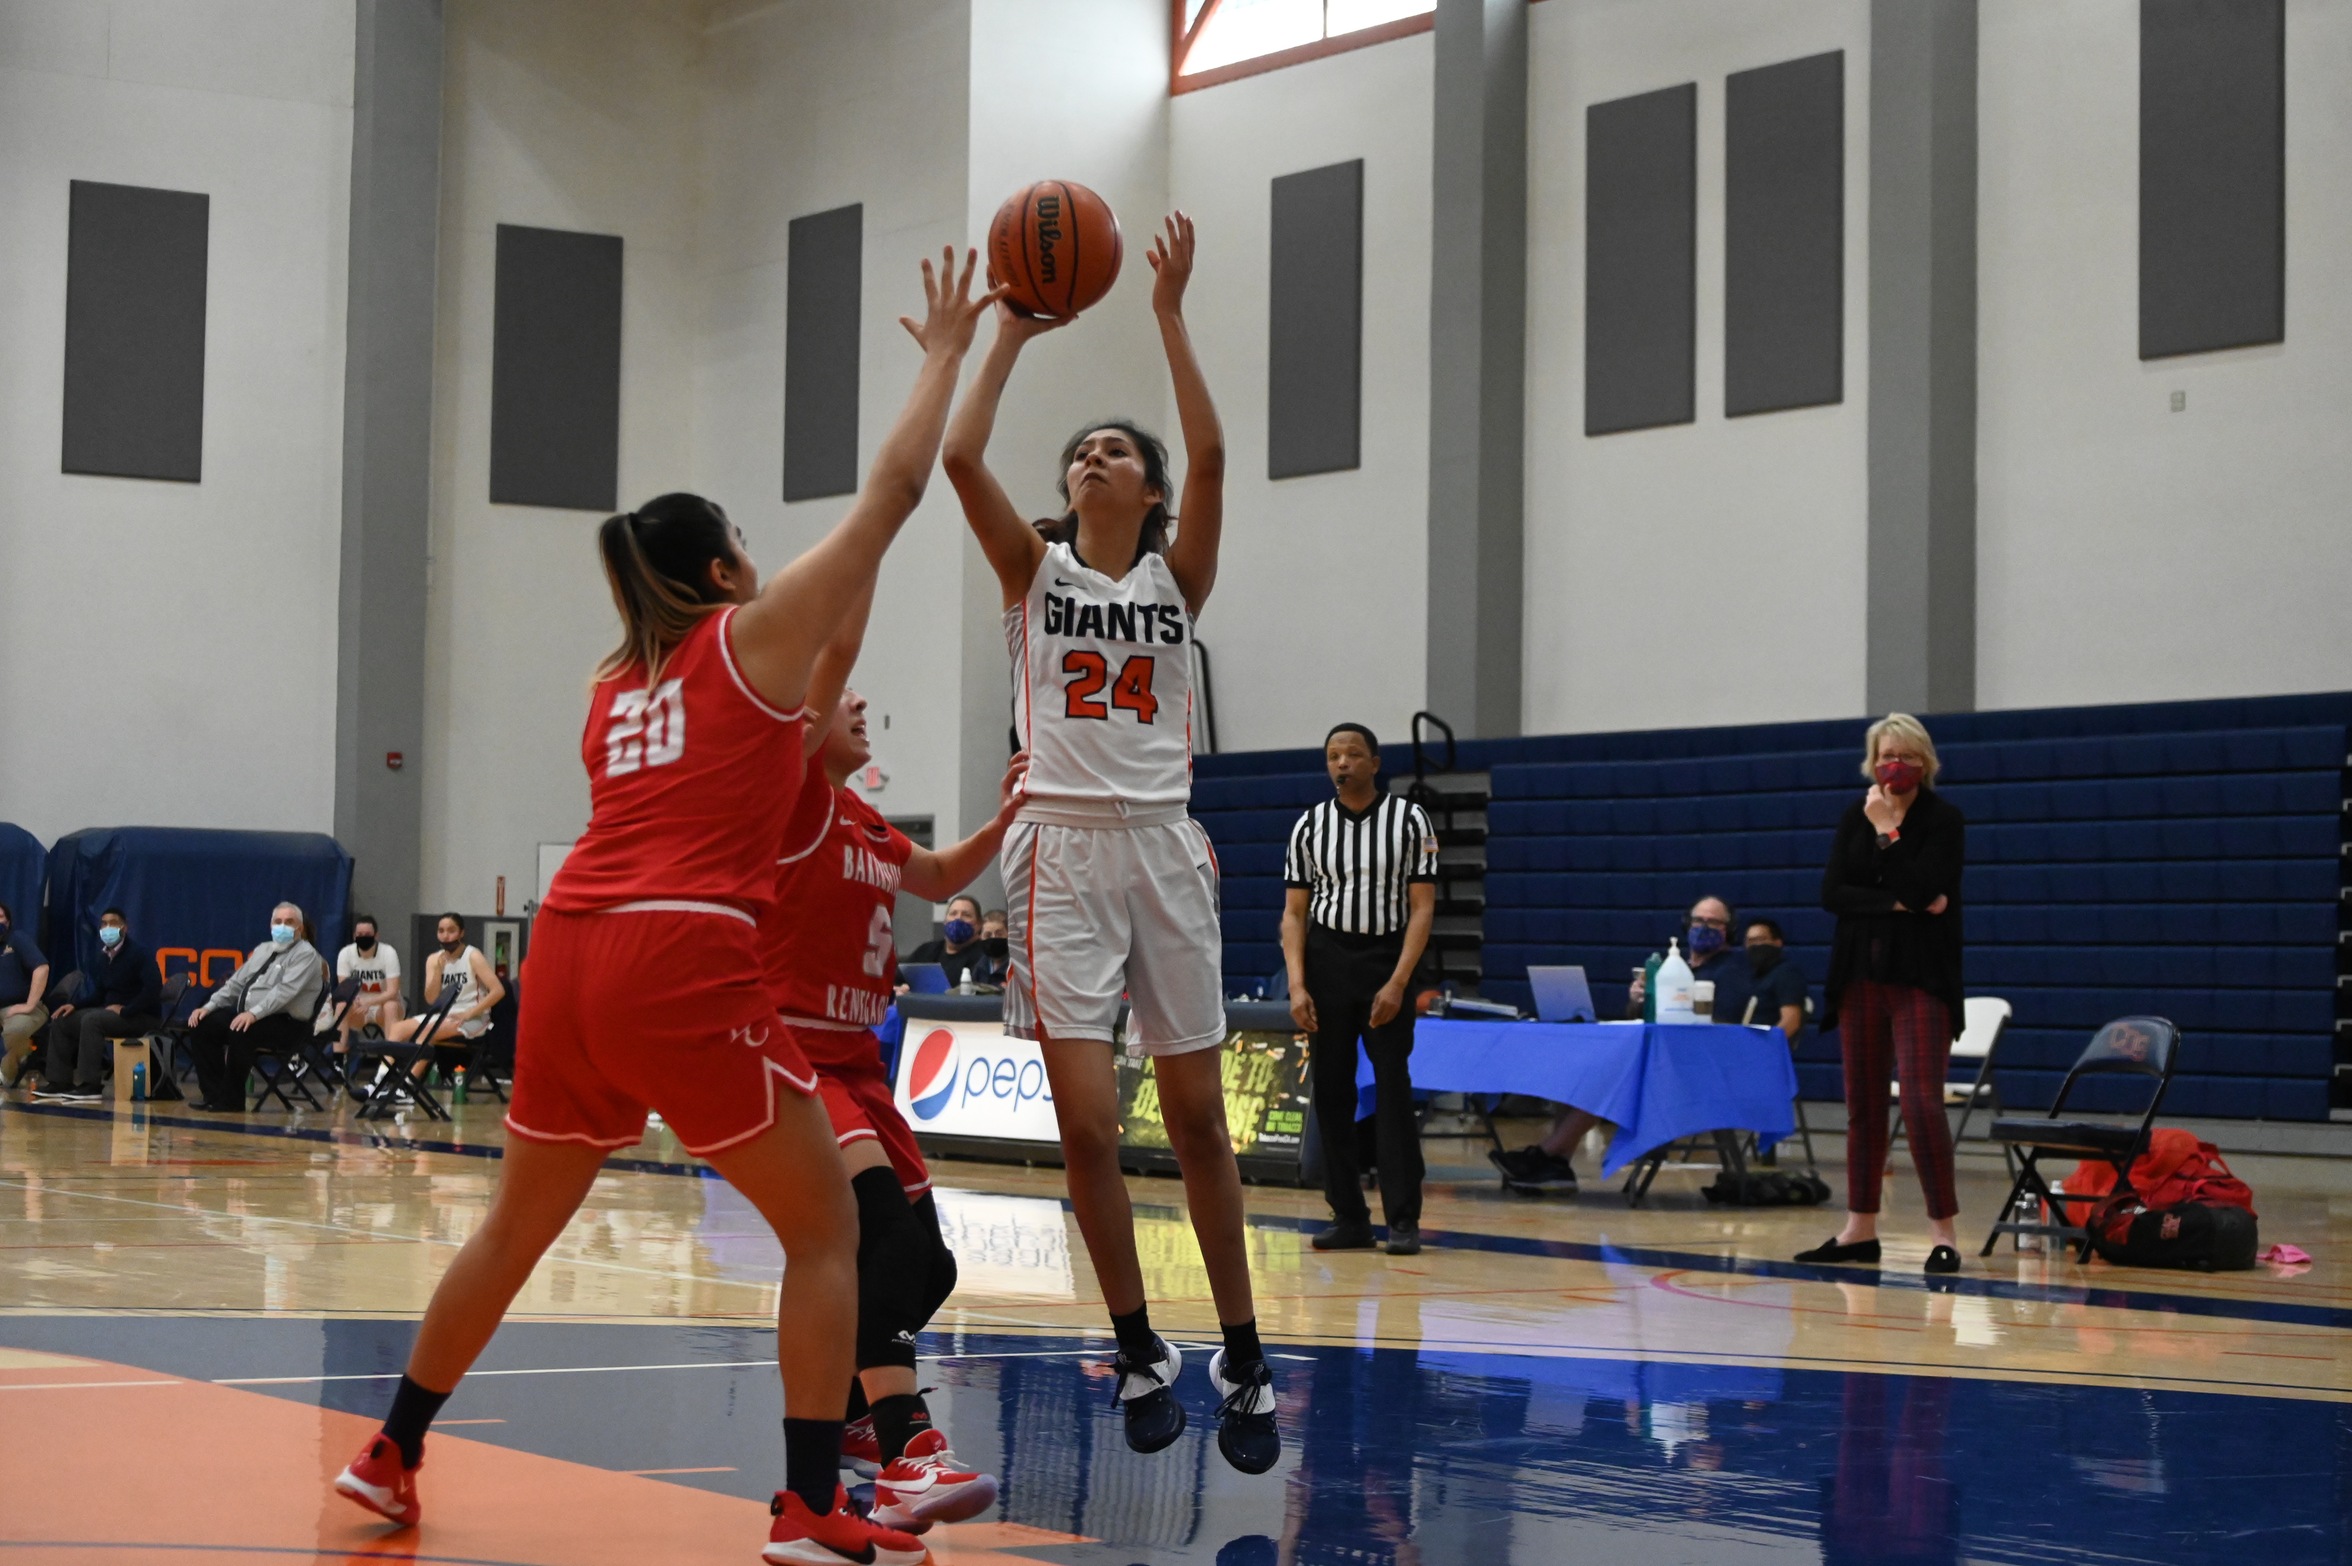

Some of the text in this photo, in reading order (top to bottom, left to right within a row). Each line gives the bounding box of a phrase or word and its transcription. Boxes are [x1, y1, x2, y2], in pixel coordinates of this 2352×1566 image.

[1036, 195, 1062, 284] Wilson
[1044, 591, 1184, 645] GIANTS
[1062, 649, 1158, 725] 24
[605, 678, 686, 778] 20
[156, 947, 255, 988] CO
[863, 903, 894, 978] 5
[441, 972, 468, 985] IANTS
[962, 1057, 1053, 1112] pep
